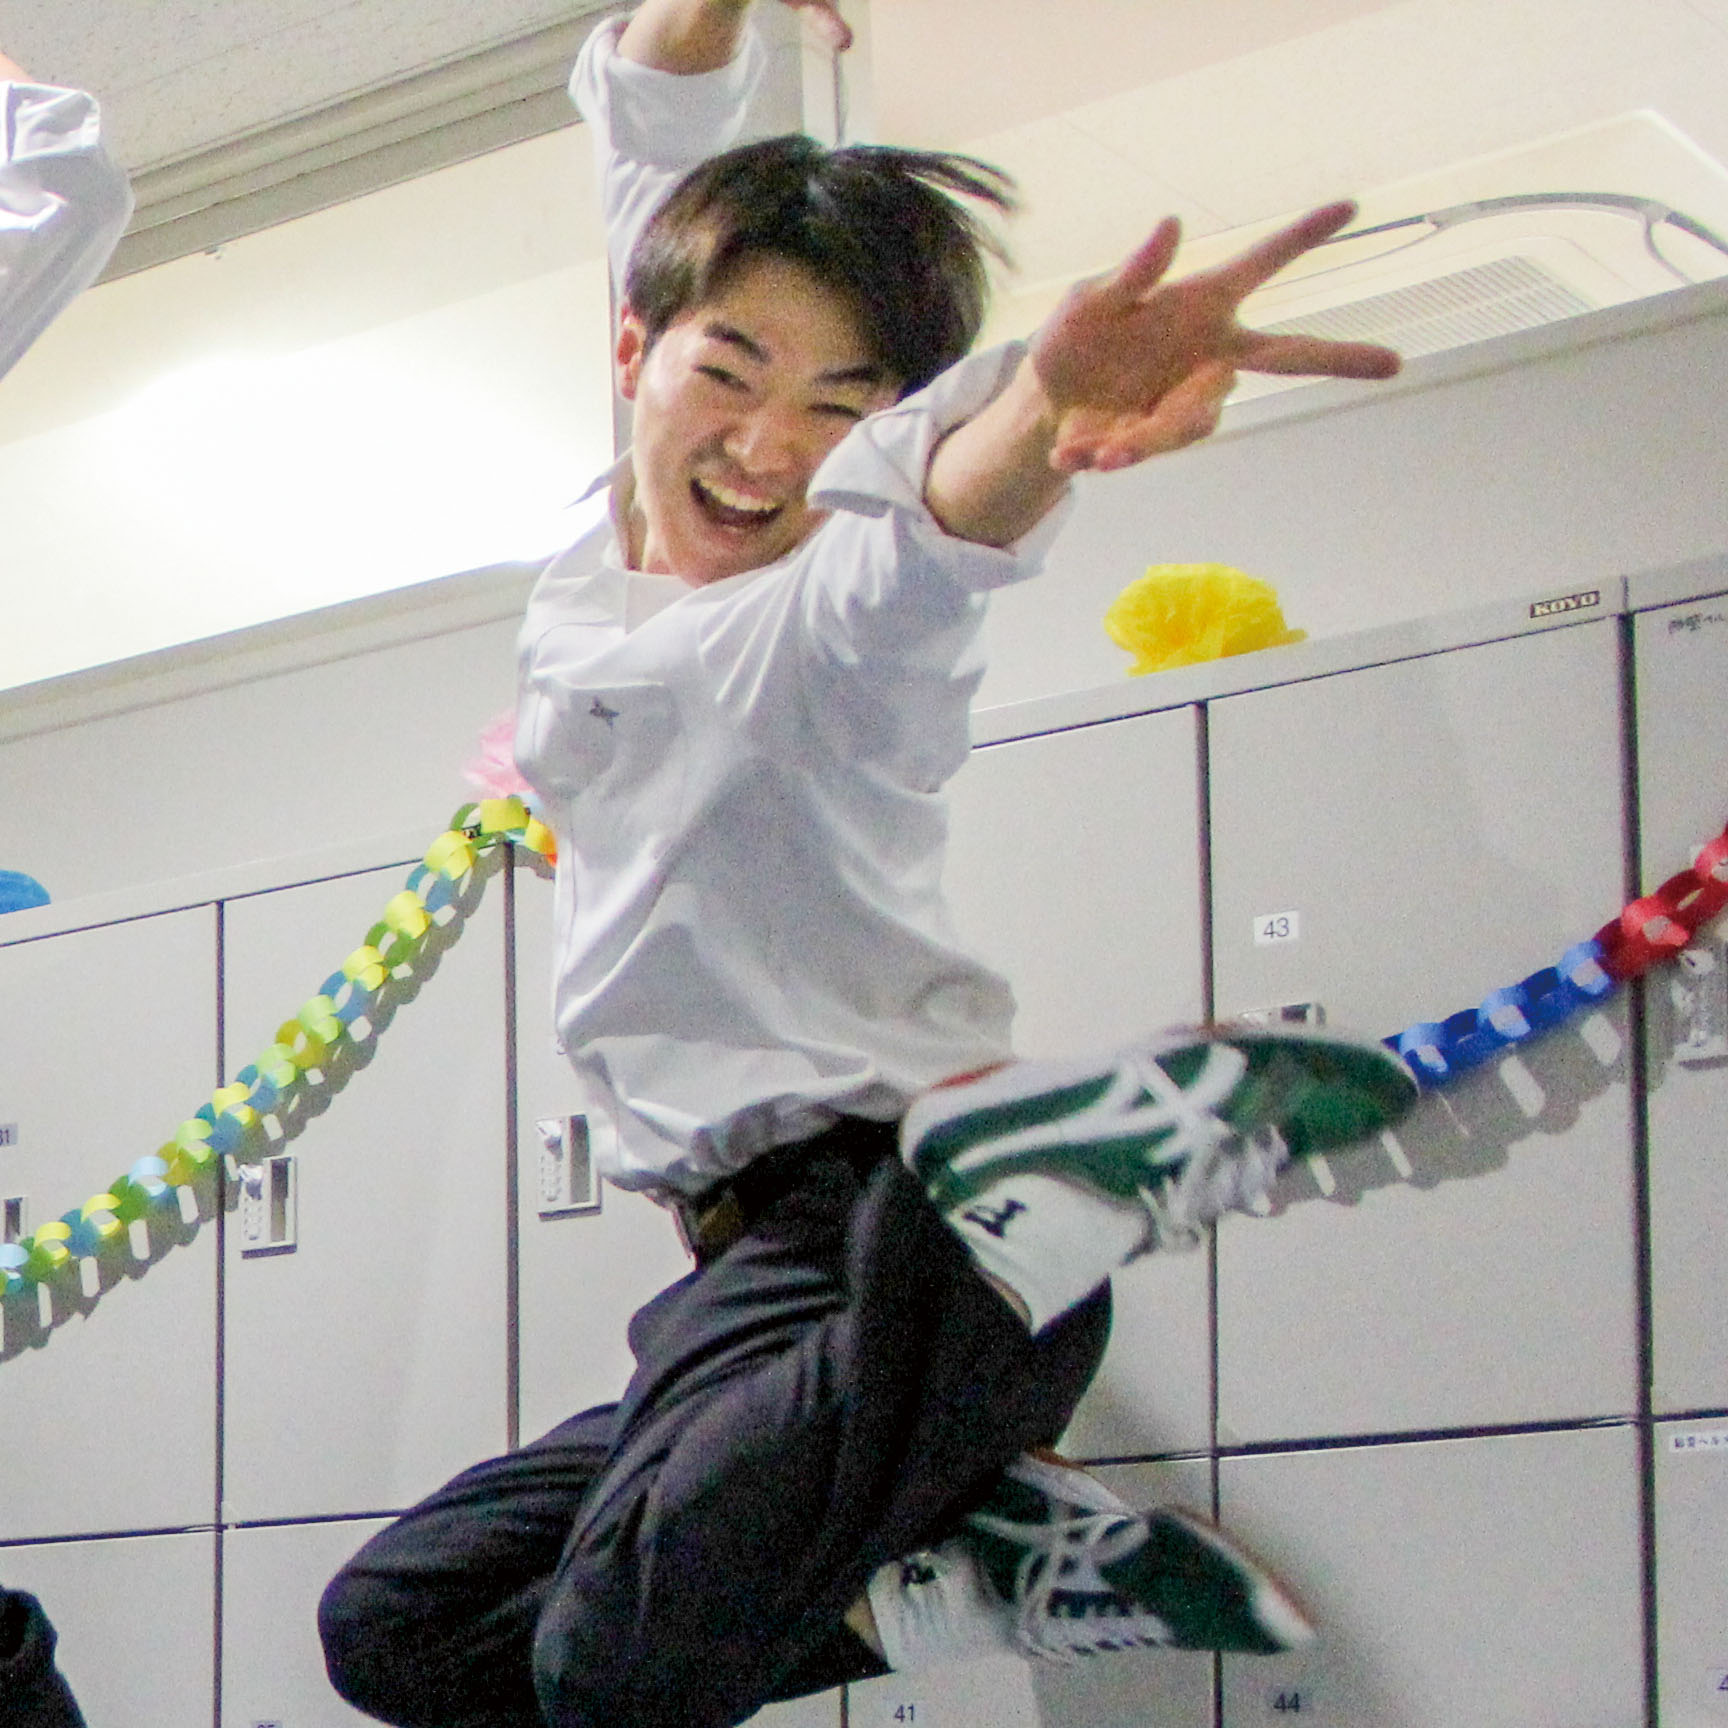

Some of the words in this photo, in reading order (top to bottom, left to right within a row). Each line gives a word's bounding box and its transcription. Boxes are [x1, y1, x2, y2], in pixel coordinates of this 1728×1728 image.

[1263, 917, 1289, 938] 43
[1273, 1692, 1301, 1713] 44
[893, 1704, 915, 1723] 41
